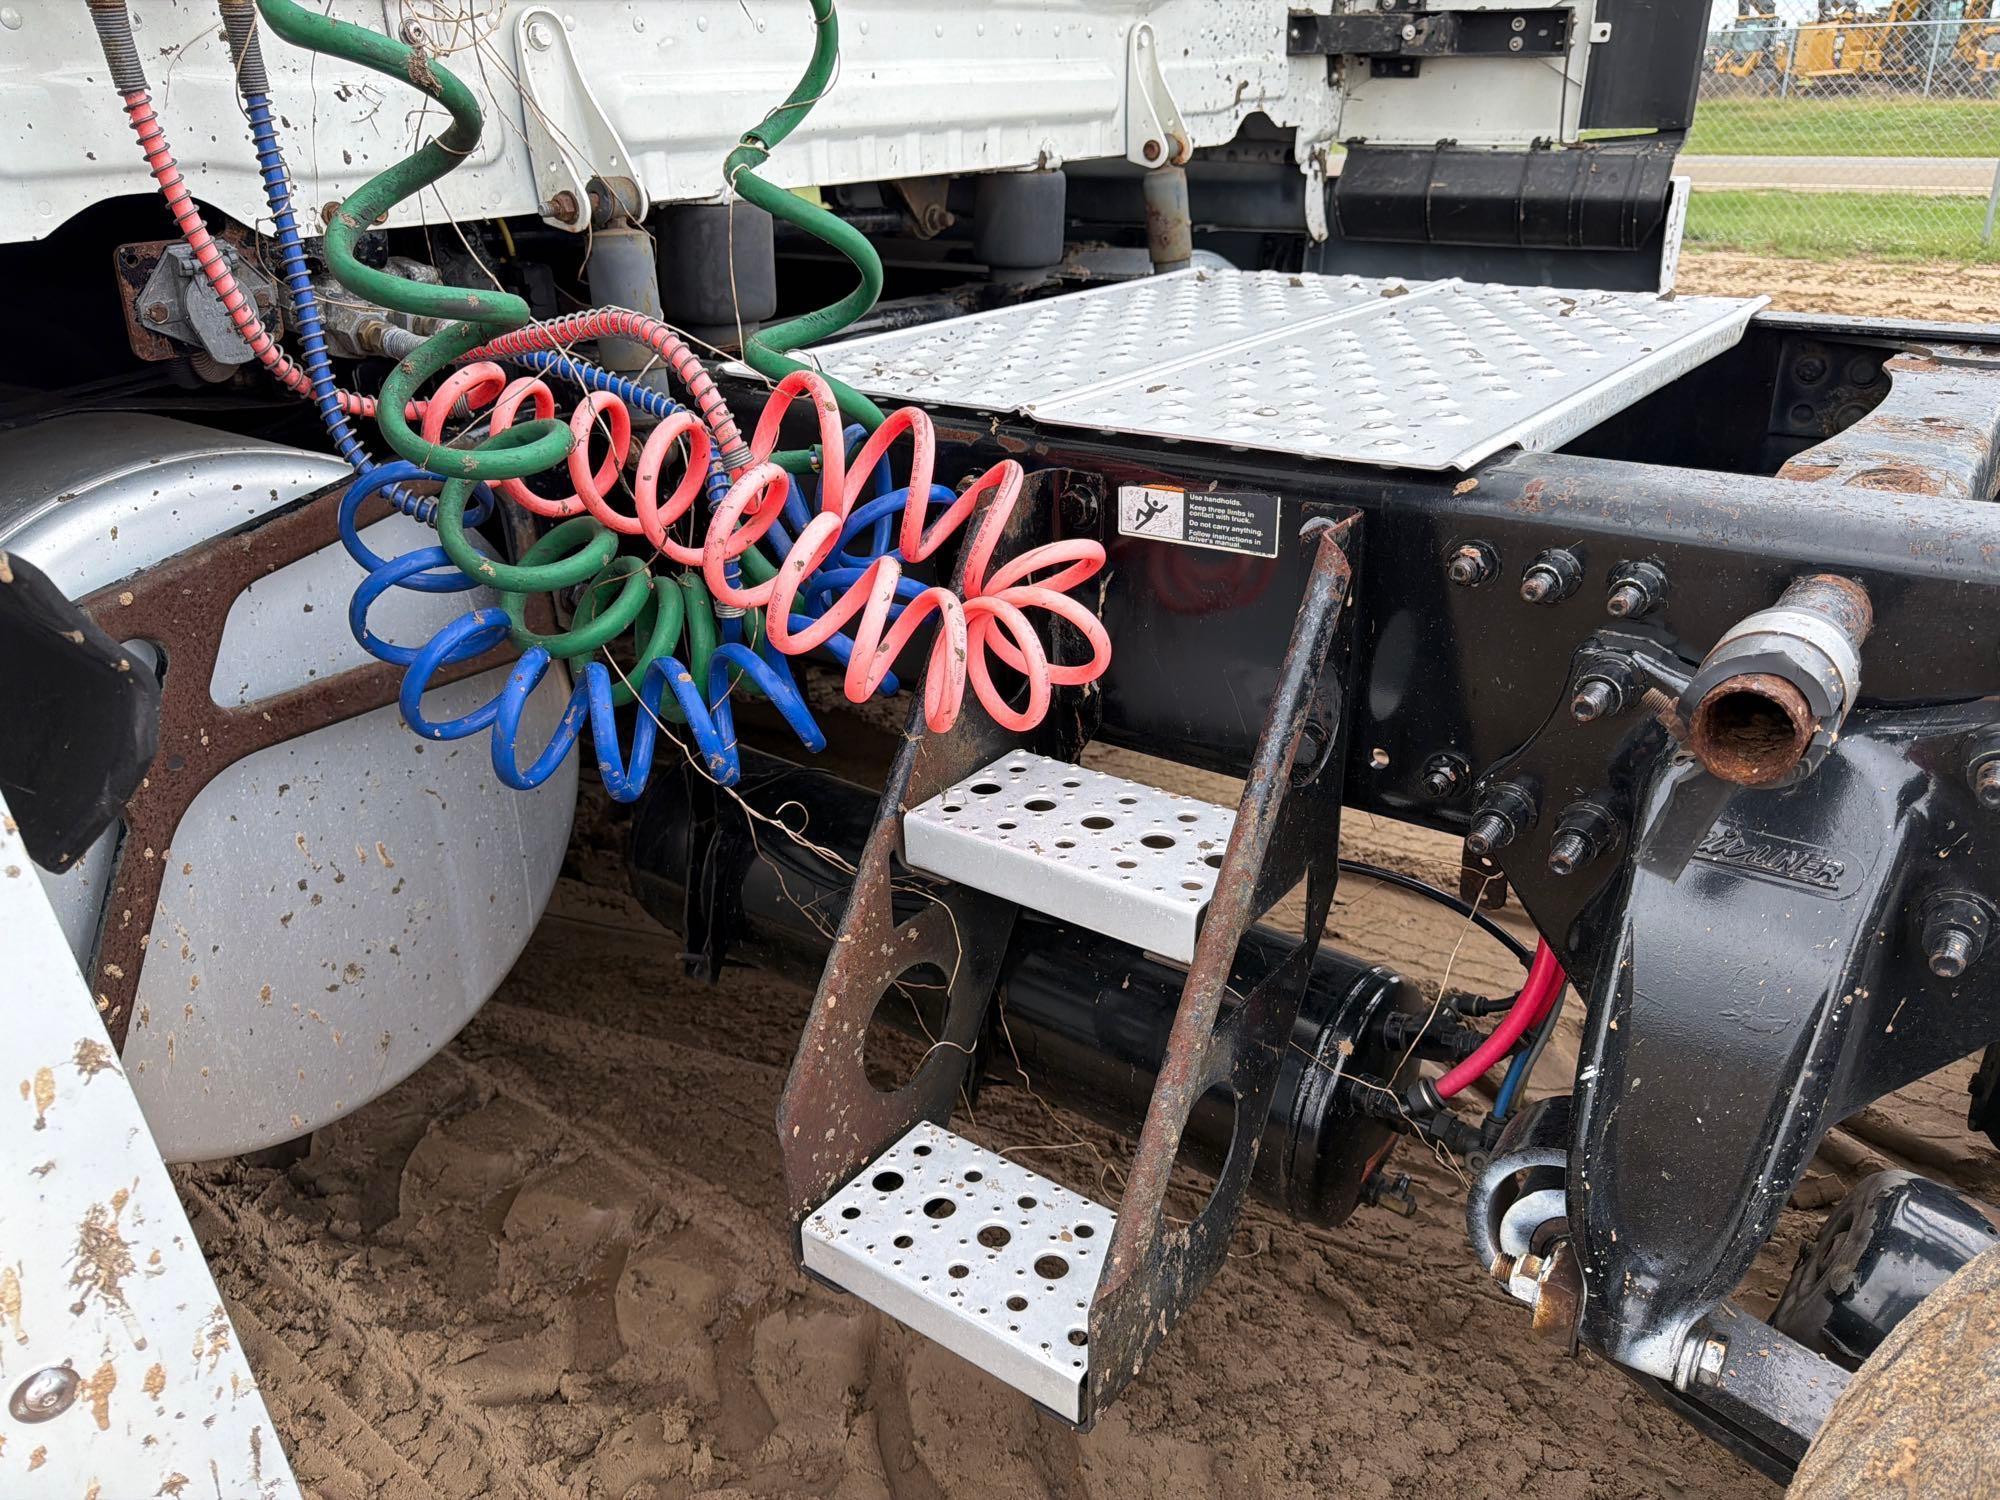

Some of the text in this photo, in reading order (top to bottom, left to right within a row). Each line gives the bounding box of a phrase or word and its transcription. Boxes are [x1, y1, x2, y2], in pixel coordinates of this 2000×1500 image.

[1204, 496, 1242, 506] handholds.
[1189, 504, 1207, 513] Keep
[1208, 506, 1226, 514] three
[1227, 508, 1246, 517] limbs
[1189, 511, 1214, 519] contact
[1231, 515, 1251, 524] truck.
[1212, 524, 1230, 533] carry
[1231, 527, 1264, 537] anything.
[1188, 536, 1242, 548] driver's manual.
[1189, 529, 1261, 546] Follow instructions in
[769, 592, 782, 624] 09/07/21
